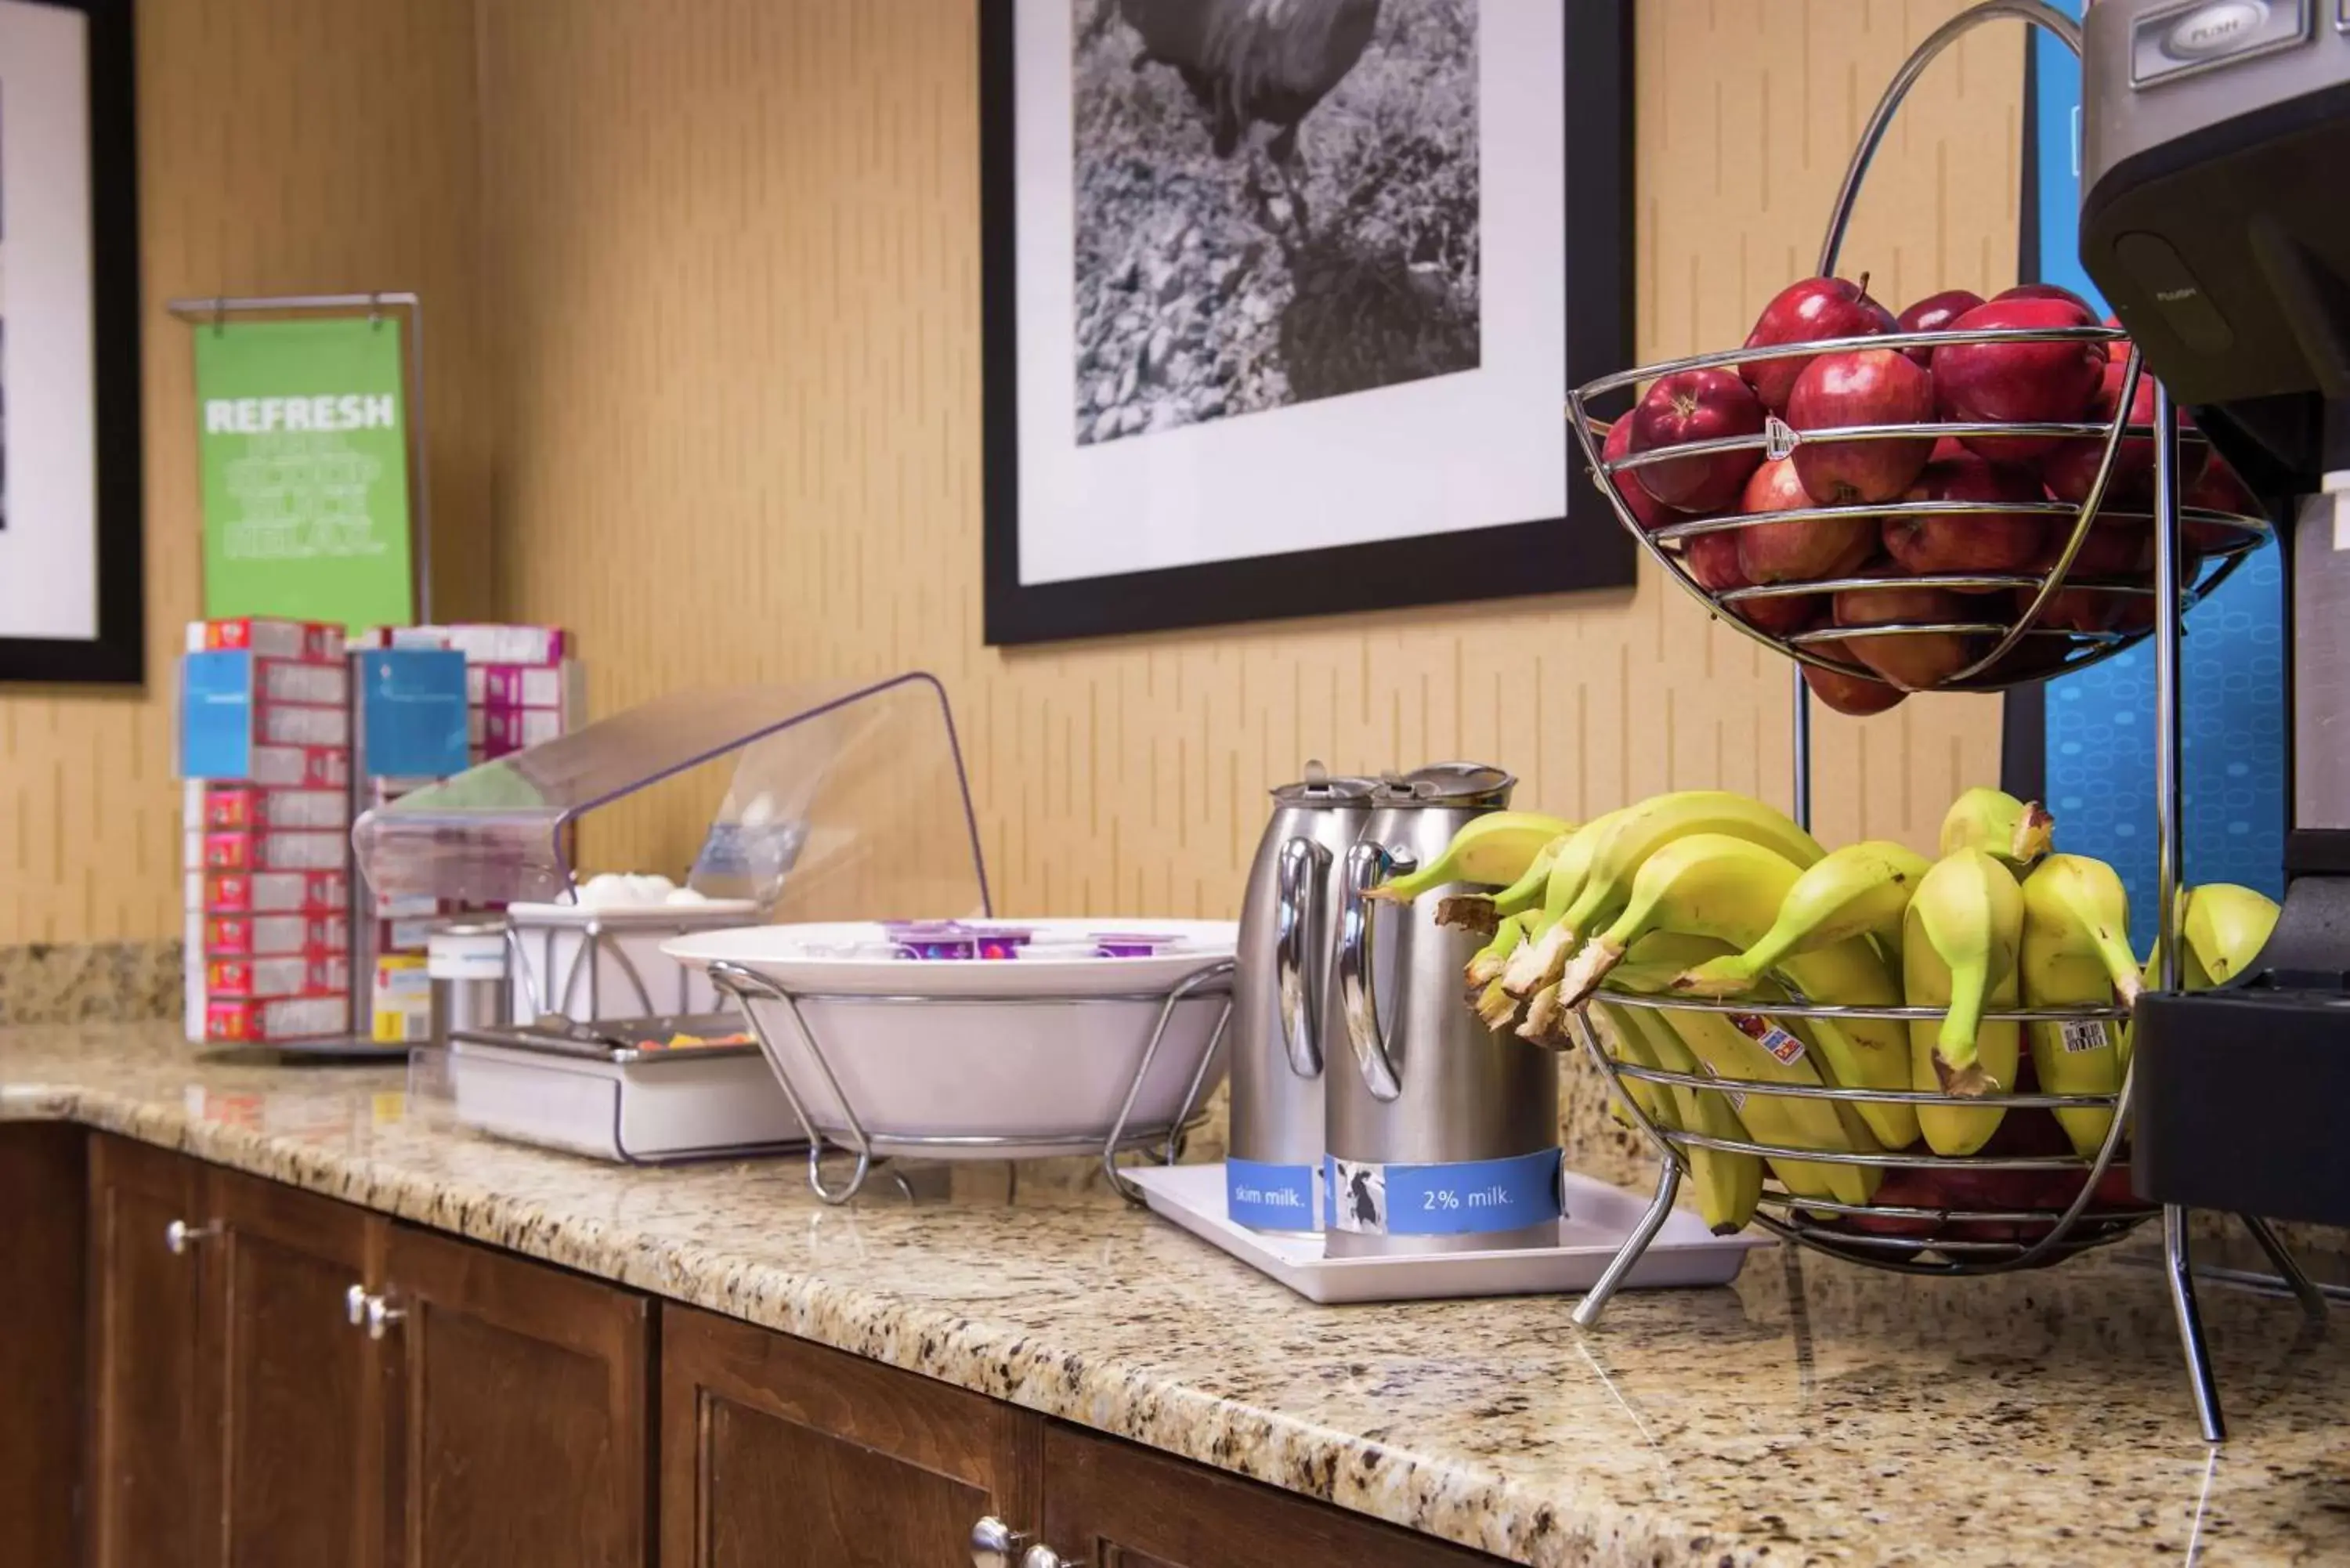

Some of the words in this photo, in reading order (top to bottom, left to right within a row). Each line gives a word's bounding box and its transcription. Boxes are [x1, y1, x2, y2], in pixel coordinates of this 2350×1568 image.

[2191, 19, 2240, 41] PUSH
[205, 392, 395, 435] REFRESH
[1235, 1183, 1261, 1204] skim
[1265, 1185, 1305, 1208] milk.
[1423, 1190, 1459, 1210] 2%
[1468, 1183, 1513, 1207] milk.
